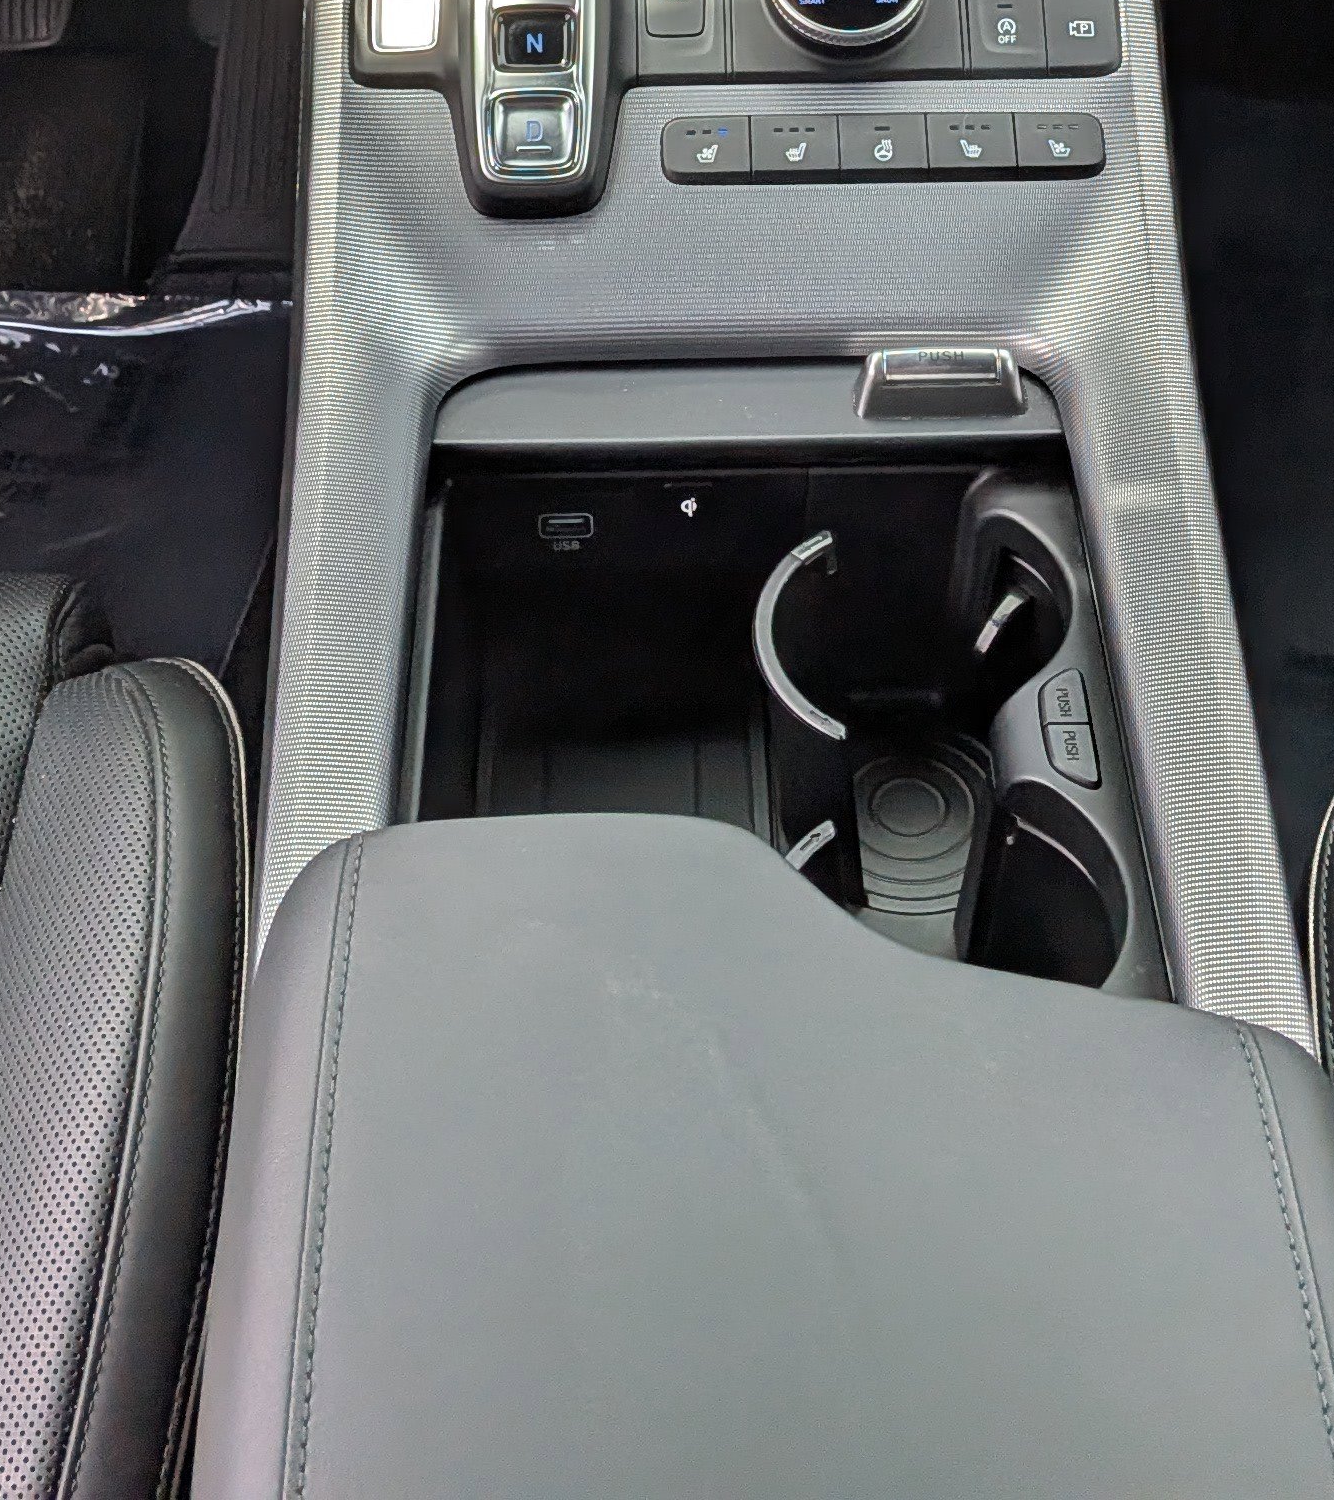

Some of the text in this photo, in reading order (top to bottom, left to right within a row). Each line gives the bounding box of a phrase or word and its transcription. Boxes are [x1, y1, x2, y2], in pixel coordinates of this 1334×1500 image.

[526, 33, 543, 53] N
[997, 35, 1017, 44] OFF
[525, 120, 543, 142] D
[918, 350, 964, 362] PUSH
[553, 540, 580, 551] USB
[1056, 687, 1072, 718] PUSH
[1063, 730, 1080, 761] PUSH
